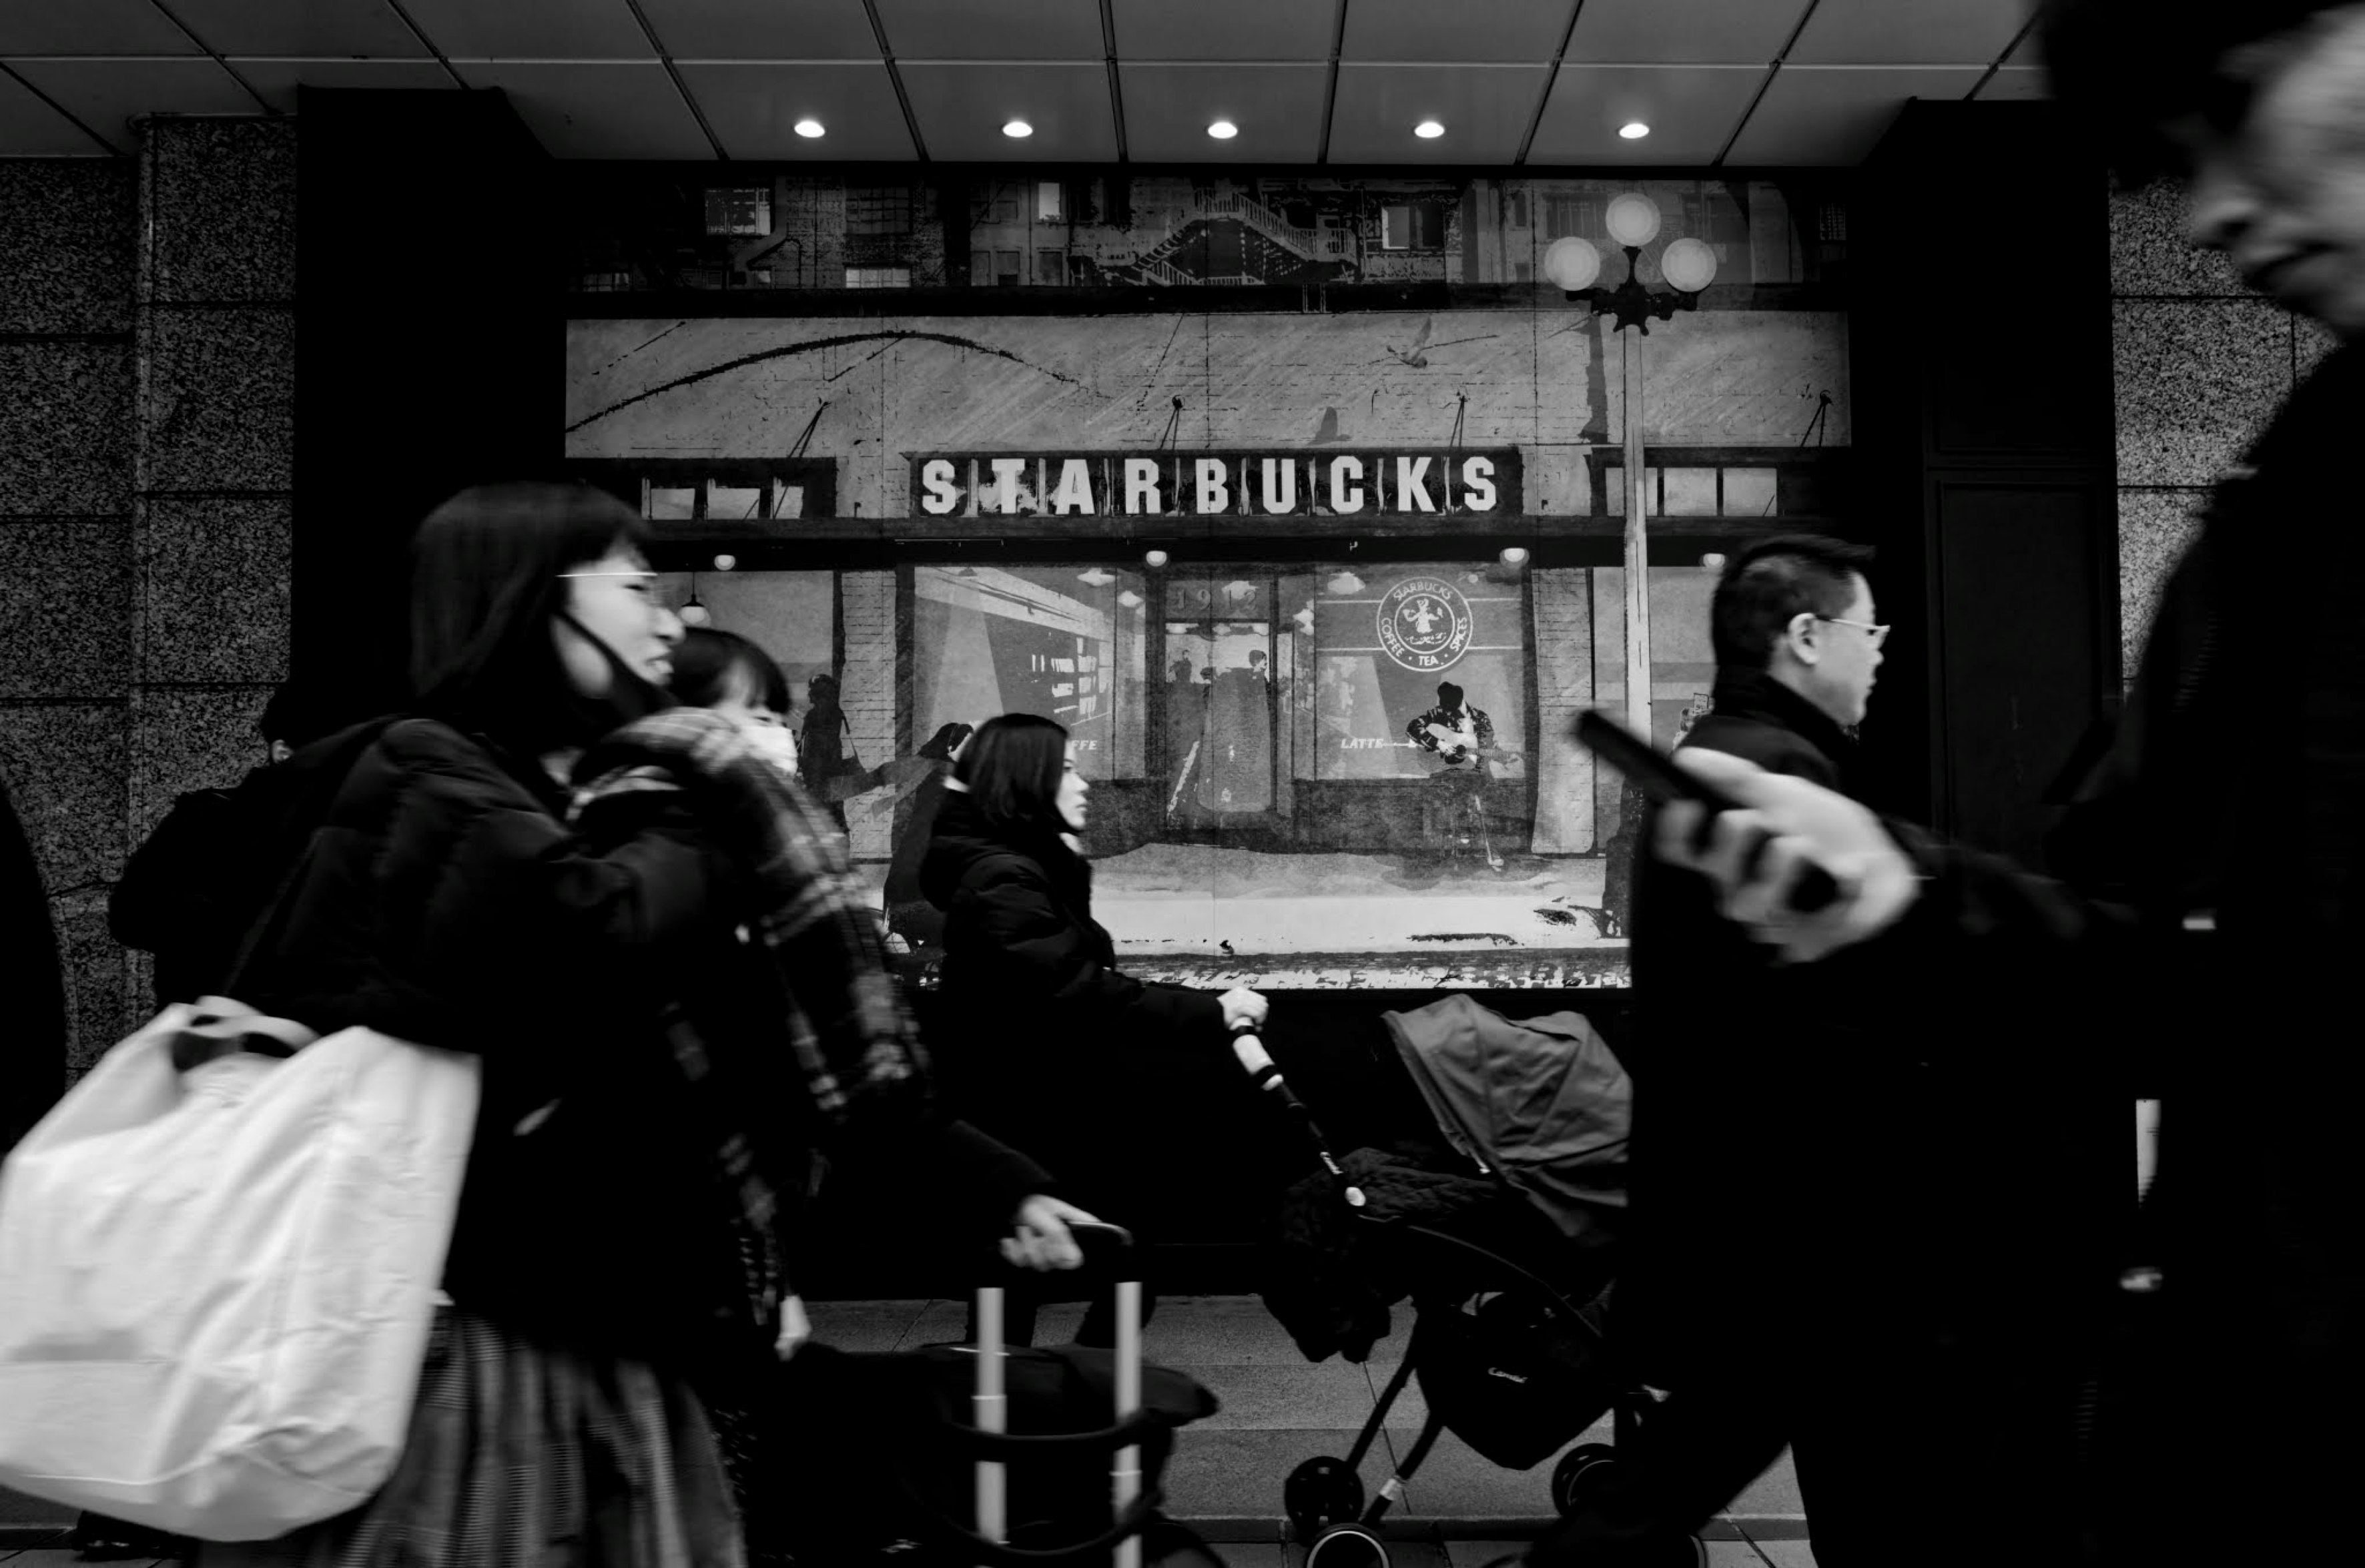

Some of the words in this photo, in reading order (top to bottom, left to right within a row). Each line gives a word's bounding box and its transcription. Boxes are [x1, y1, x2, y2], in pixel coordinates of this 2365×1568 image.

[921, 456, 1497, 514] STARBUCKS
[1393, 581, 1453, 601] STARBUCKS
[1381, 617, 1405, 657] COFFEE
[1419, 655, 1439, 666] TEA
[1071, 739, 1098, 750] FFE
[1340, 738, 1384, 749] LATTE
